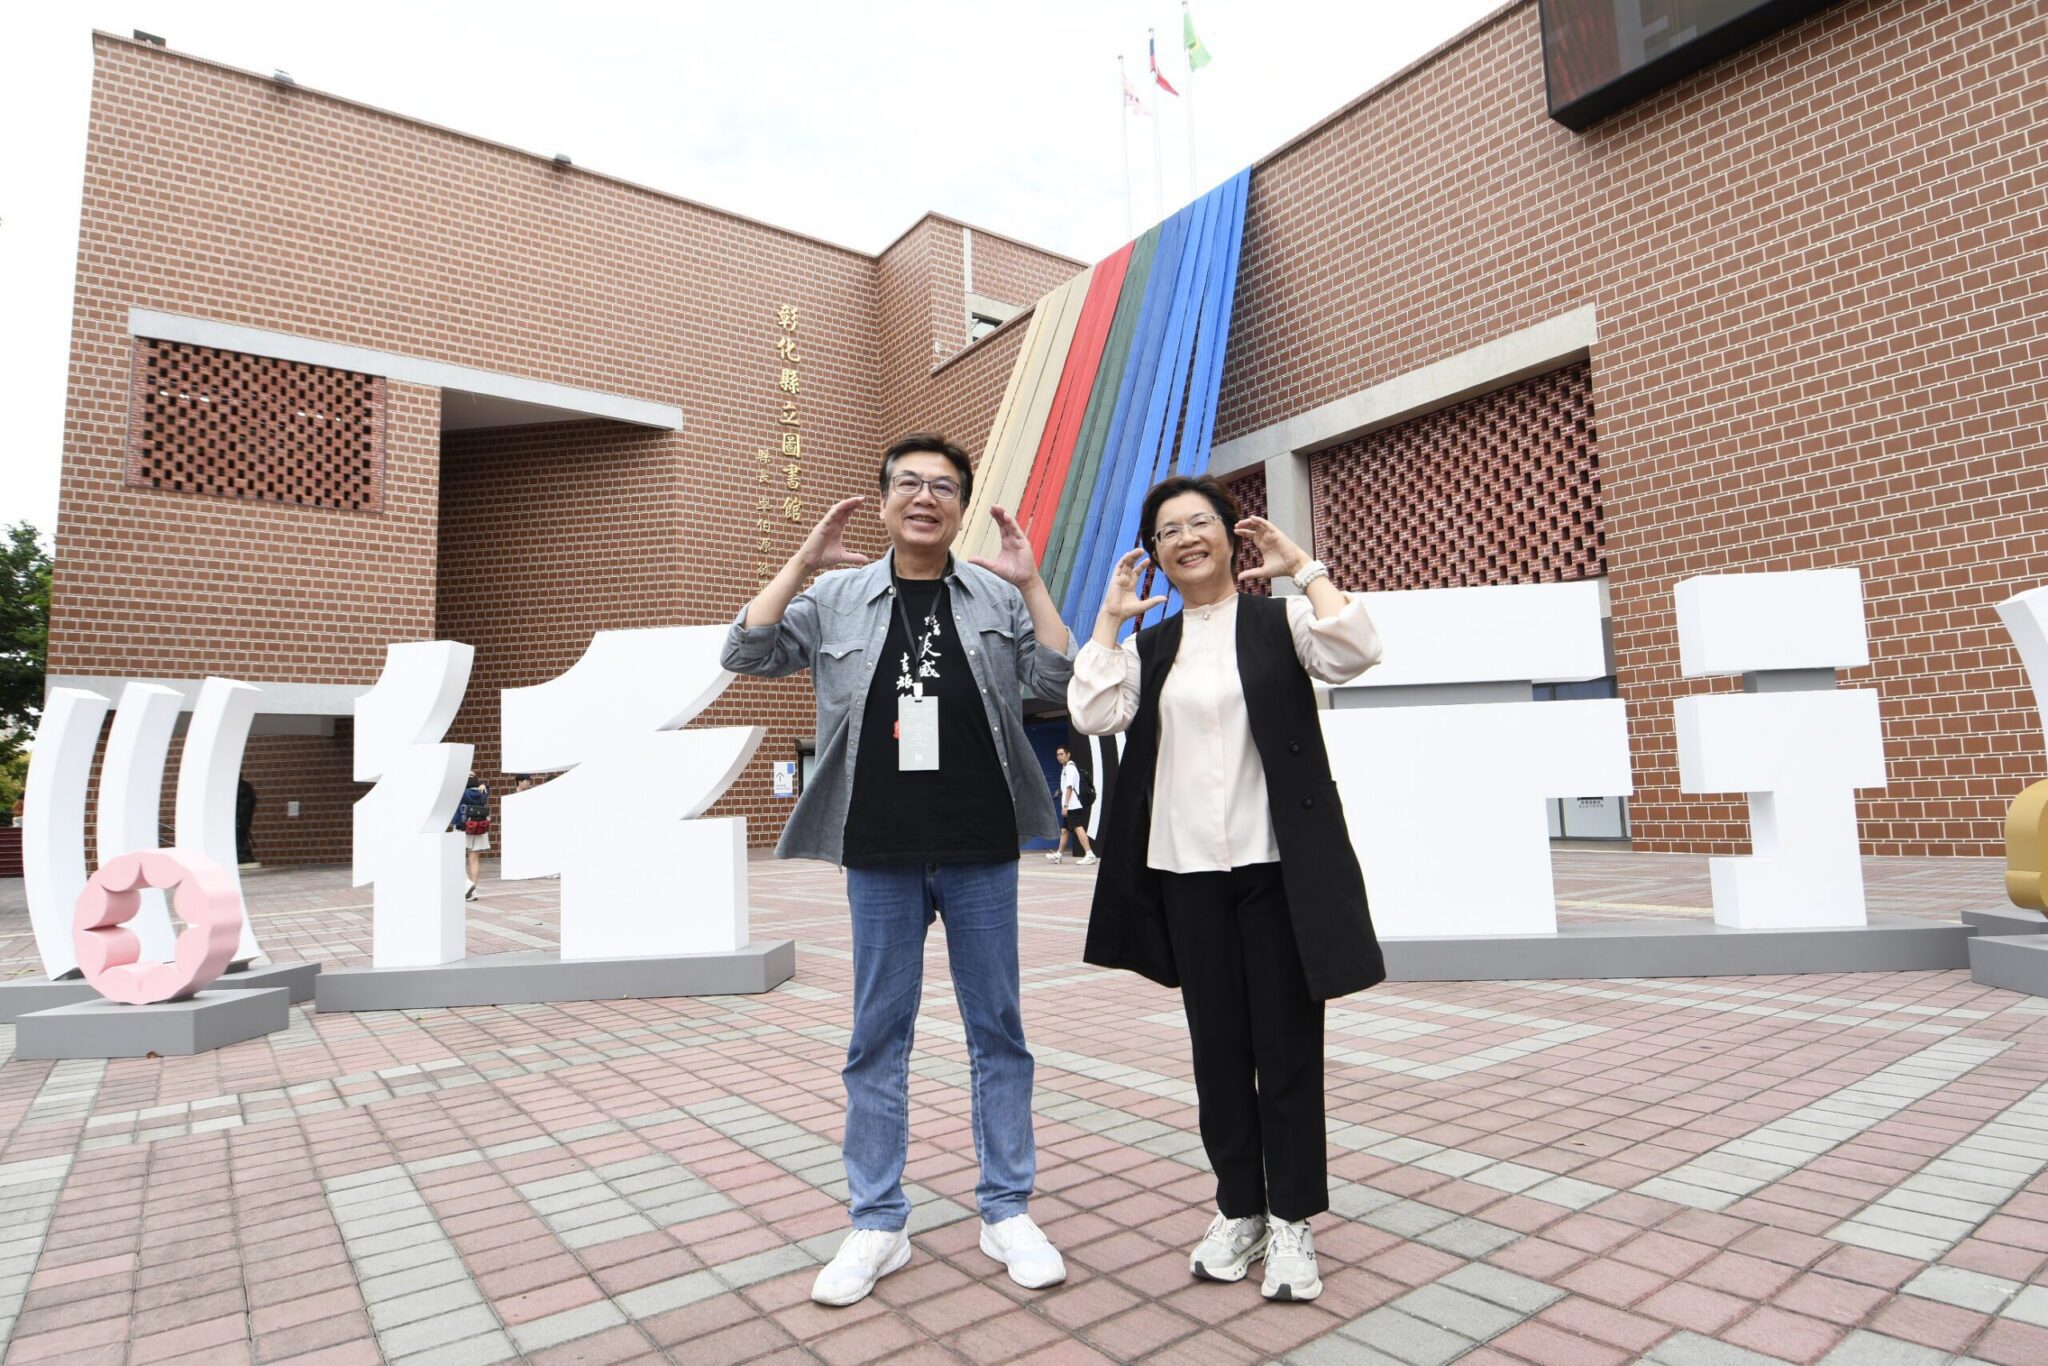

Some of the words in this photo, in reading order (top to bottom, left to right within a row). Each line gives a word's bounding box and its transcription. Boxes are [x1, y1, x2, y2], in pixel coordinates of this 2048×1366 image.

[777, 303, 802, 522] 彰化縣立圖書館
